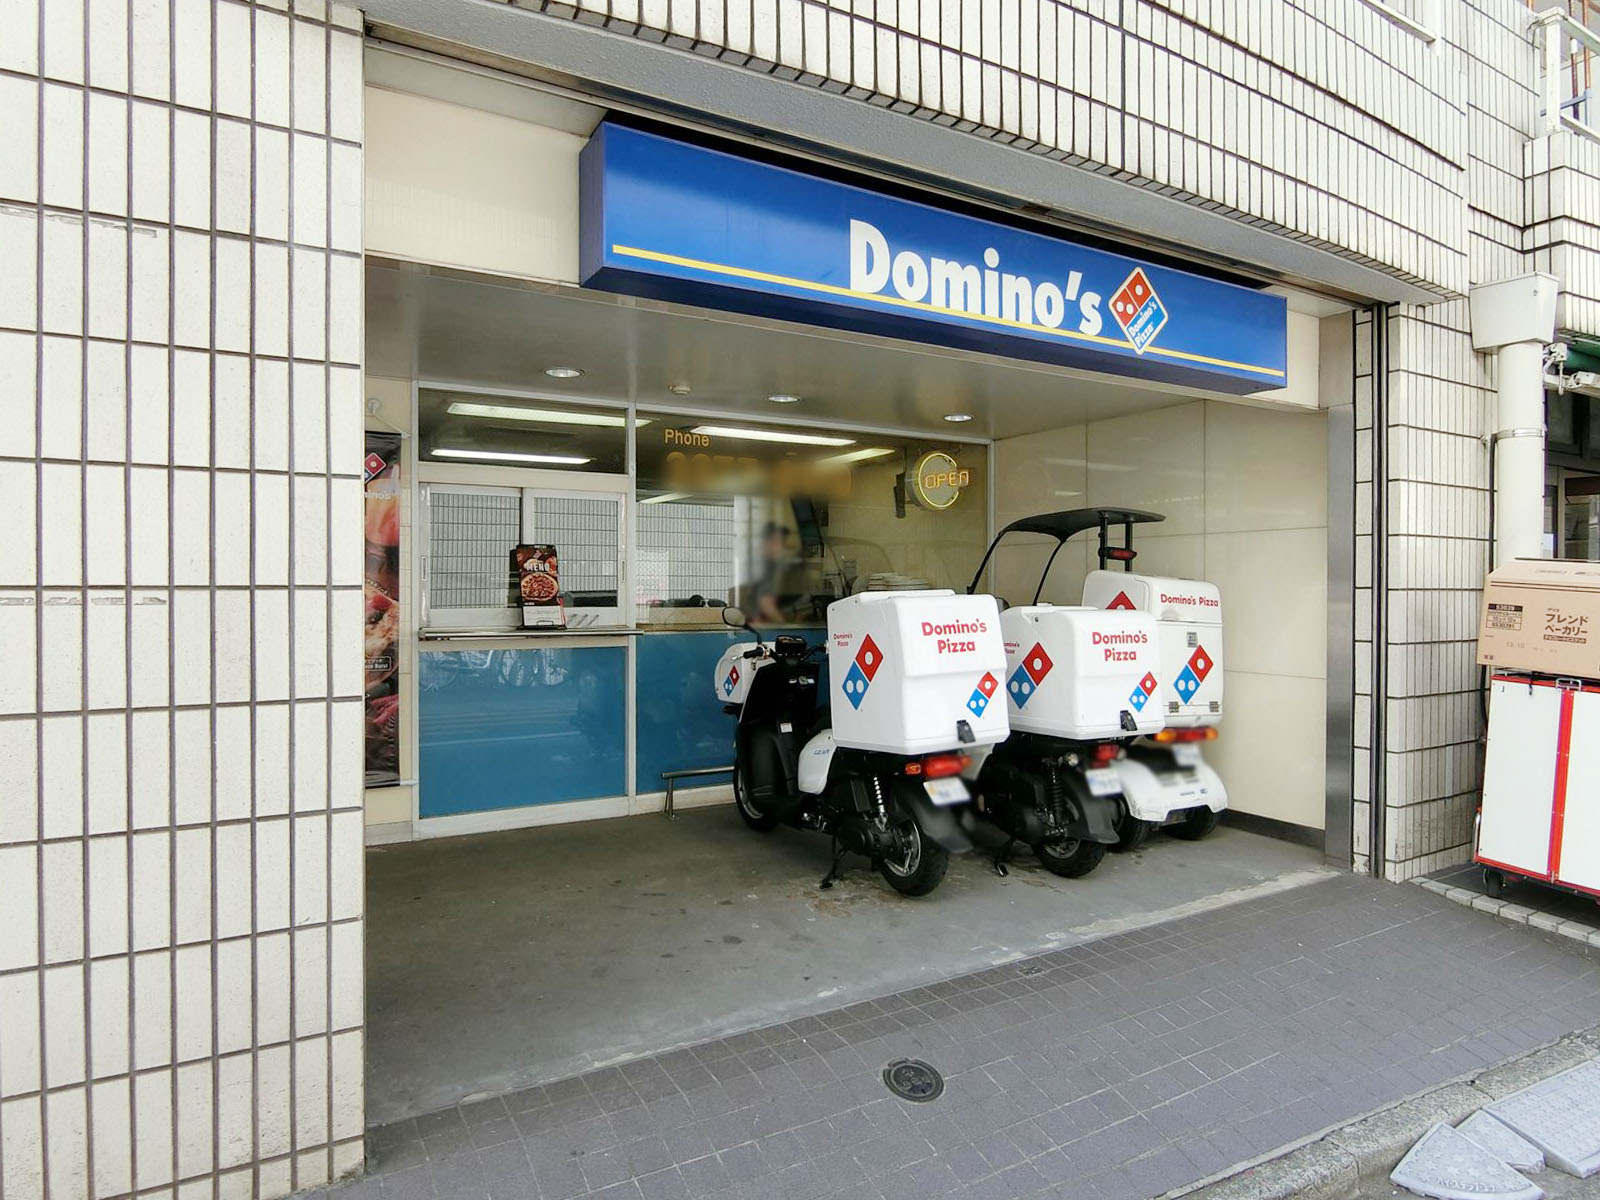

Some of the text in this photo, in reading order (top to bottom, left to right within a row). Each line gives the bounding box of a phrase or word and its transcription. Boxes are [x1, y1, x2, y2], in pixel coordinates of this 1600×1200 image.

[849, 219, 1103, 337] Domino's
[1128, 300, 1158, 337] Domino's
[1134, 323, 1154, 348] Pizza
[664, 428, 711, 448] Phone
[925, 471, 969, 489] OPEN
[1160, 593, 1219, 607] Domino's Pizza
[921, 618, 987, 638] Domino's
[1545, 613, 1589, 626] フレンド
[937, 639, 976, 654] Pizza
[1092, 630, 1148, 645] Domino's
[1104, 648, 1137, 662] Pizza
